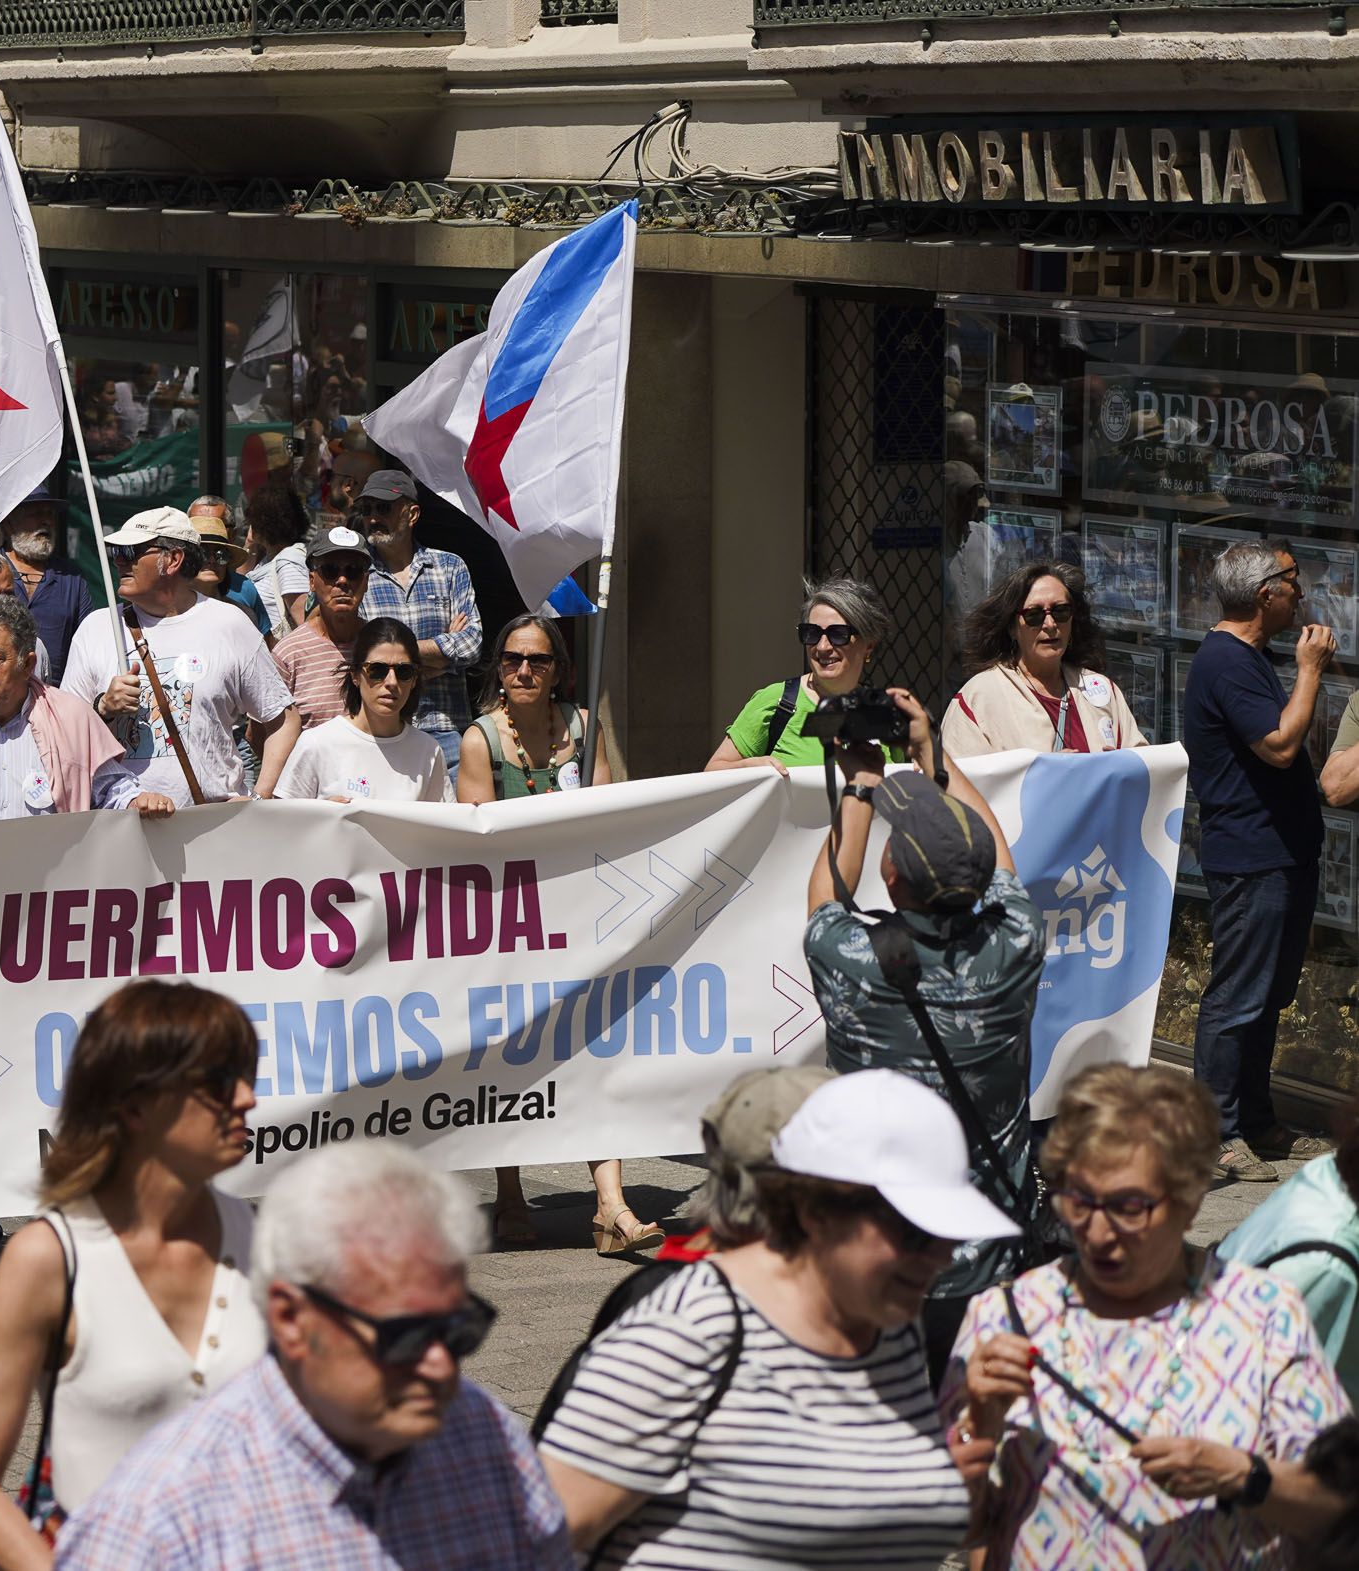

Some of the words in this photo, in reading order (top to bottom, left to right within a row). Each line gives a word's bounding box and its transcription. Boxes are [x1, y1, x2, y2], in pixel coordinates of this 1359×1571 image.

[838, 127, 1268, 205] INMOBILIARIA
[58, 280, 176, 333] ARESSO
[1065, 250, 1322, 311] PEDROSA
[1135, 389, 1338, 460] PEDROSA
[1133, 446, 1204, 465] AGENCIA
[1216, 453, 1338, 478] INMOBILIARIA
[347, 778, 371, 798] bng
[380, 859, 568, 963] VIDA.
[464, 961, 753, 1072] FUTURO.
[364, 1096, 410, 1141] de
[420, 1080, 558, 1132] Galiza!
